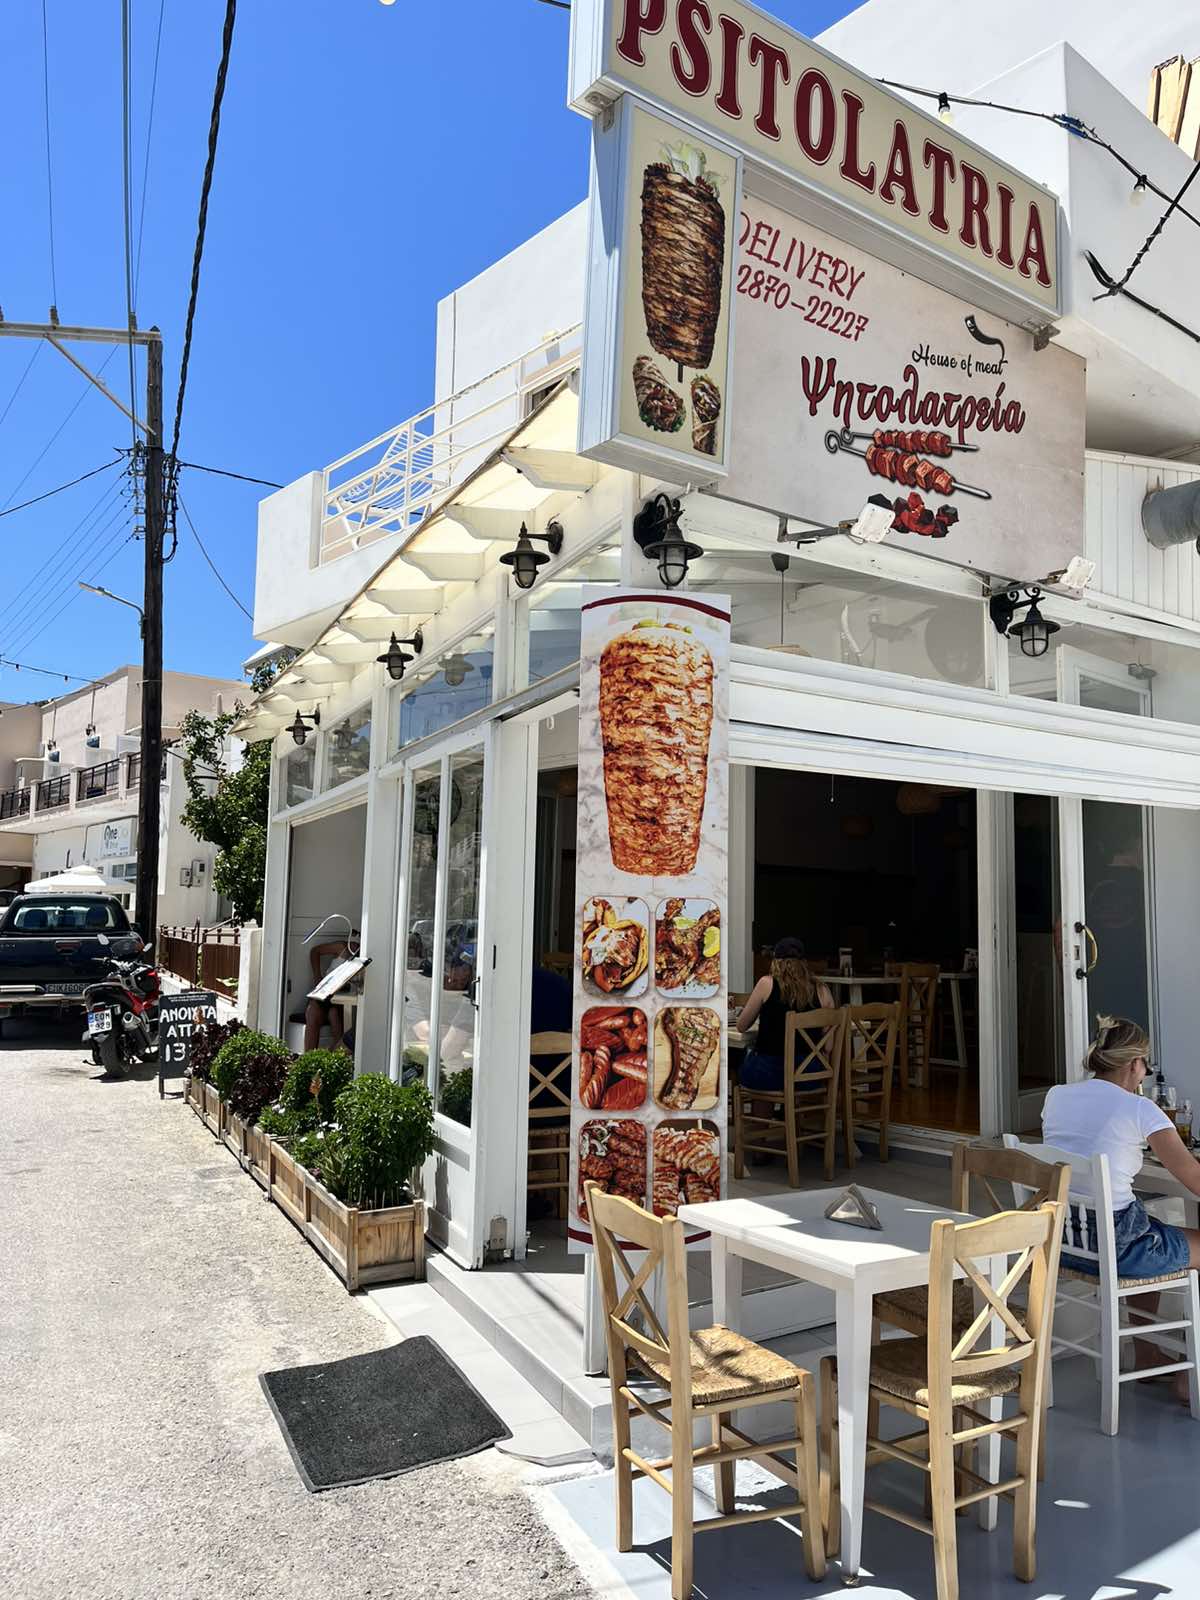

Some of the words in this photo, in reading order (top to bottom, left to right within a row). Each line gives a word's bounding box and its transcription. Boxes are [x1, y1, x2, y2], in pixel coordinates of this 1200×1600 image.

[616, 0, 1053, 289] PSITOLATRIA
[801, 355, 1026, 450] Ψητολατρεία
[911, 343, 958, 369] House
[960, 353, 973, 378] of
[975, 356, 1009, 376] meat
